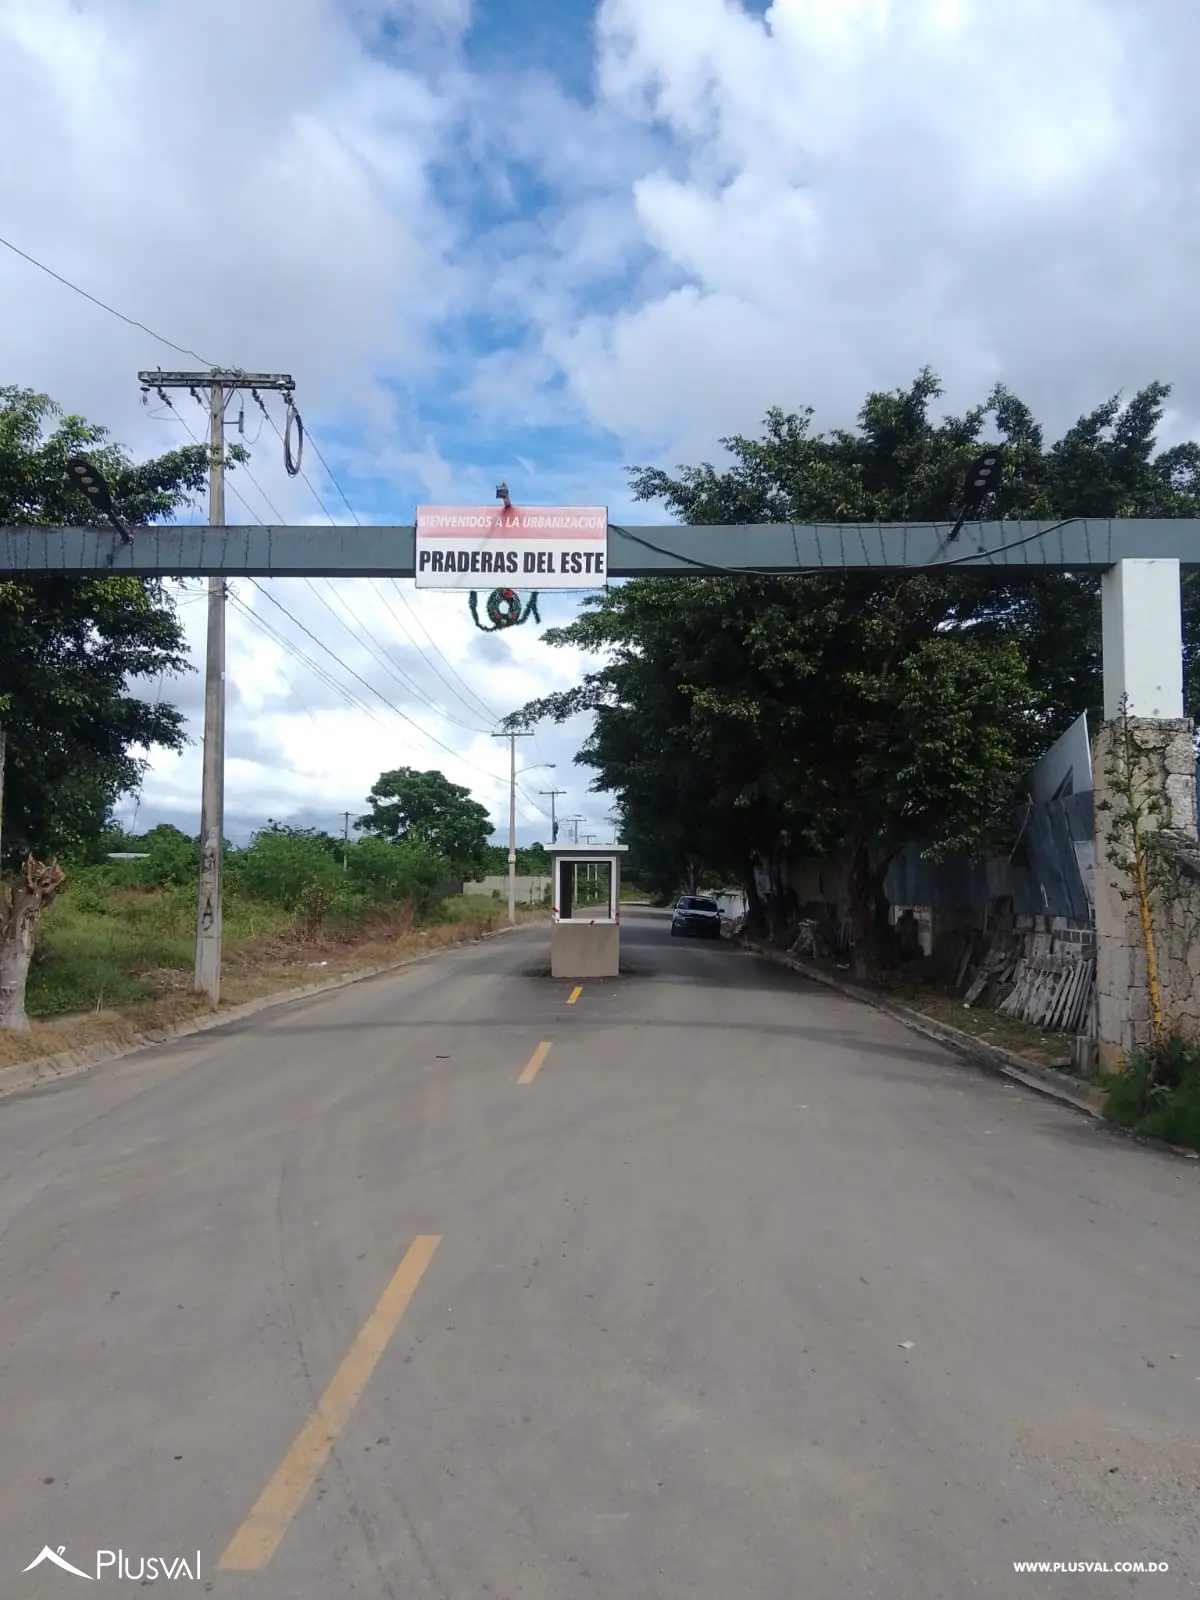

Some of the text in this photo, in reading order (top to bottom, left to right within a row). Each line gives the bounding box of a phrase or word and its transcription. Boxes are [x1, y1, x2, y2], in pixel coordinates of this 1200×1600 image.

[419, 515, 606, 529] BIENVENIDOS A LA URBANIZACION
[419, 550, 604, 574] PRADERAS DEL ESTE
